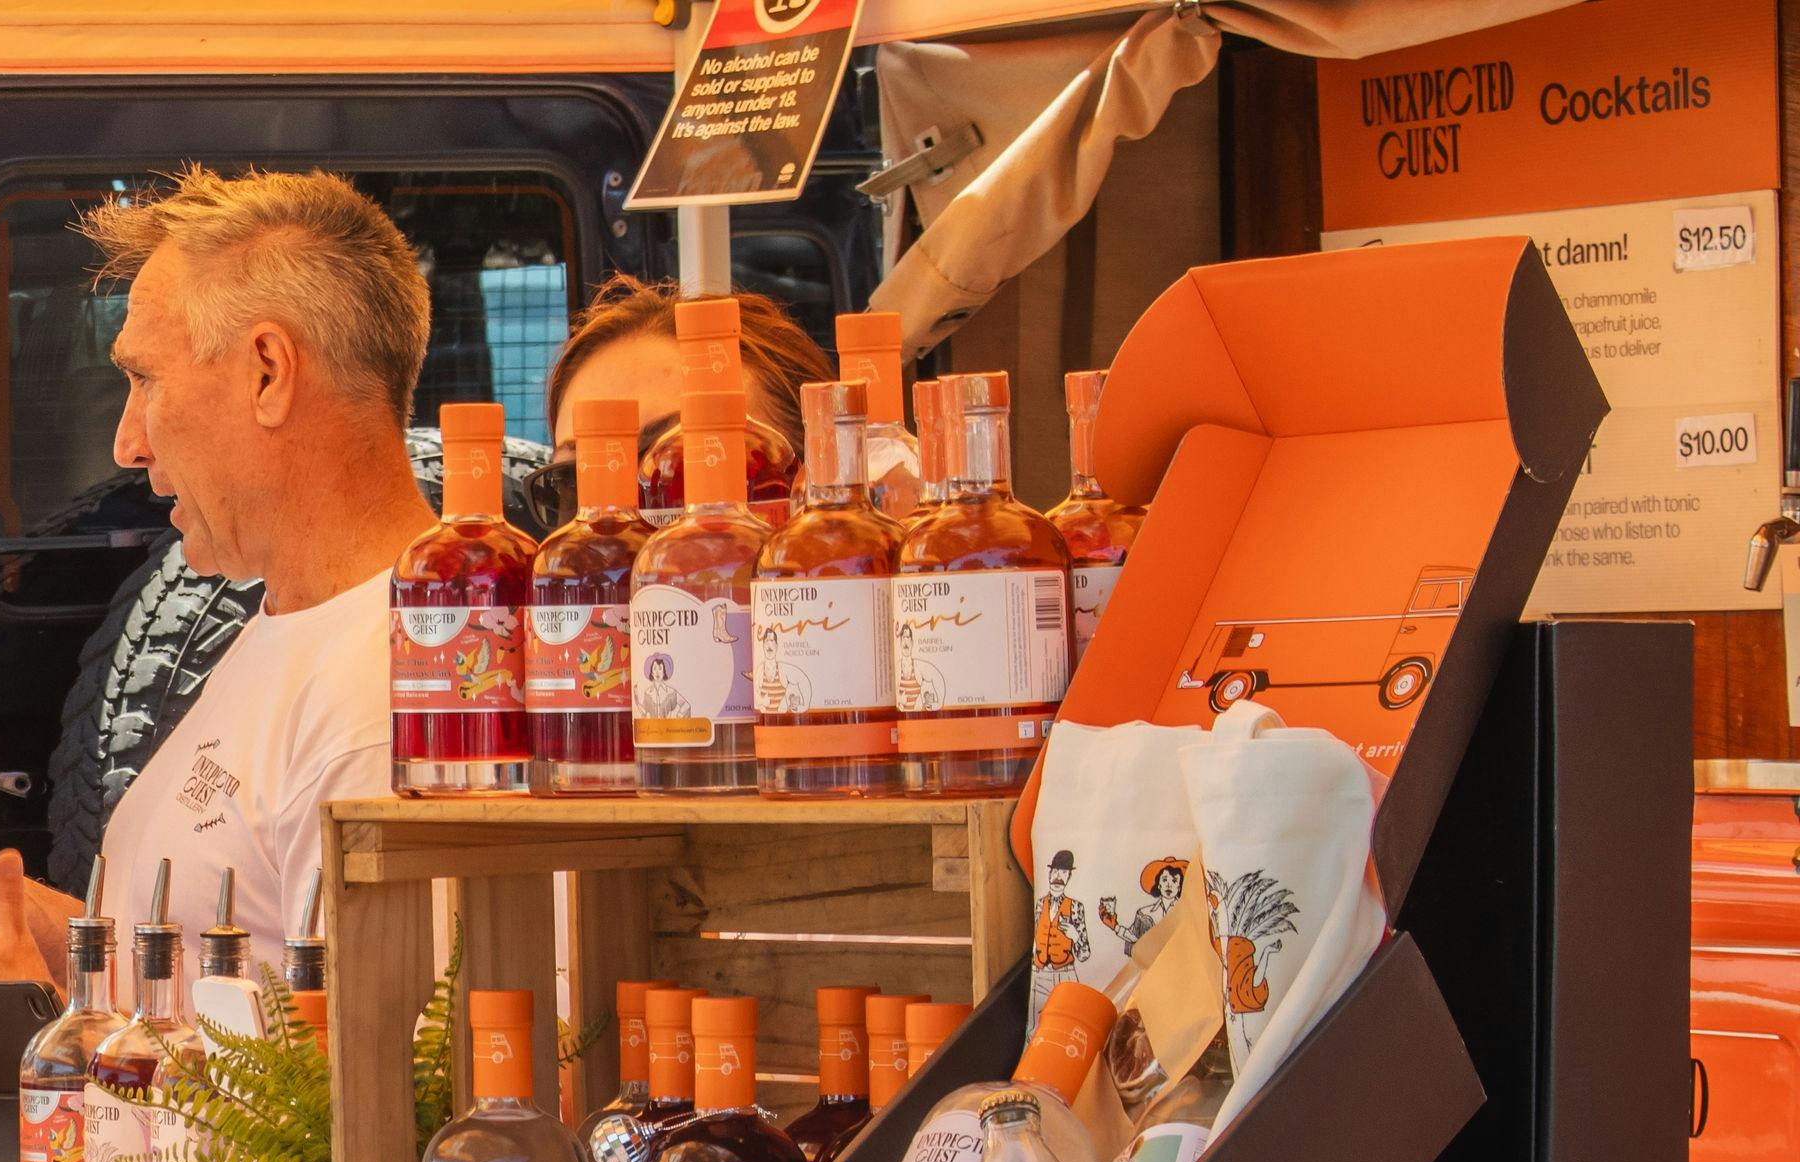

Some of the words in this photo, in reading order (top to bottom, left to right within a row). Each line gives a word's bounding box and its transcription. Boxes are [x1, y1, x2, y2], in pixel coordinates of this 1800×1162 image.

[700, 58, 722, 76] No
[723, 53, 773, 73] alcohol
[774, 50, 801, 67] can
[801, 45, 820, 63] be
[691, 80, 723, 97] sold
[723, 79, 739, 93] or
[740, 71, 798, 94] supplied
[798, 69, 815, 85] to
[1361, 60, 1515, 127] UNEXPECTED
[1539, 67, 1712, 127] Cocktails
[681, 103, 733, 120] anyone
[734, 95, 776, 113] under
[672, 122, 694, 139] It's
[694, 117, 747, 140] against
[748, 115, 772, 133] the
[772, 112, 801, 130] law.
[1378, 124, 1462, 180] GUEST
[1679, 224, 1747, 253] $12.50
[1556, 233, 1629, 266] damn!
[1604, 343, 1618, 359] to
[1619, 339, 1662, 357] deliver
[1679, 427, 1749, 459] $10.00
[1584, 497, 1628, 519] paired
[1631, 496, 1661, 513] with
[1664, 494, 1701, 513] tonic
[1593, 523, 1623, 540] who
[1625, 521, 1663, 539] listen
[1665, 522, 1681, 538] to
[1567, 549, 1590, 567] the
[1592, 551, 1635, 566] same.
[761, 587, 818, 601] UNEXPECTED
[898, 582, 951, 598] UNEXPECTED
[765, 603, 795, 616] GUEST
[901, 598, 928, 613] GUEST
[408, 611, 456, 625] UNEXPECTED
[633, 610, 699, 627] UNEXPECTED
[412, 625, 438, 635] GUEST
[540, 623, 563, 634] GUEST
[637, 629, 672, 645] GUEST
